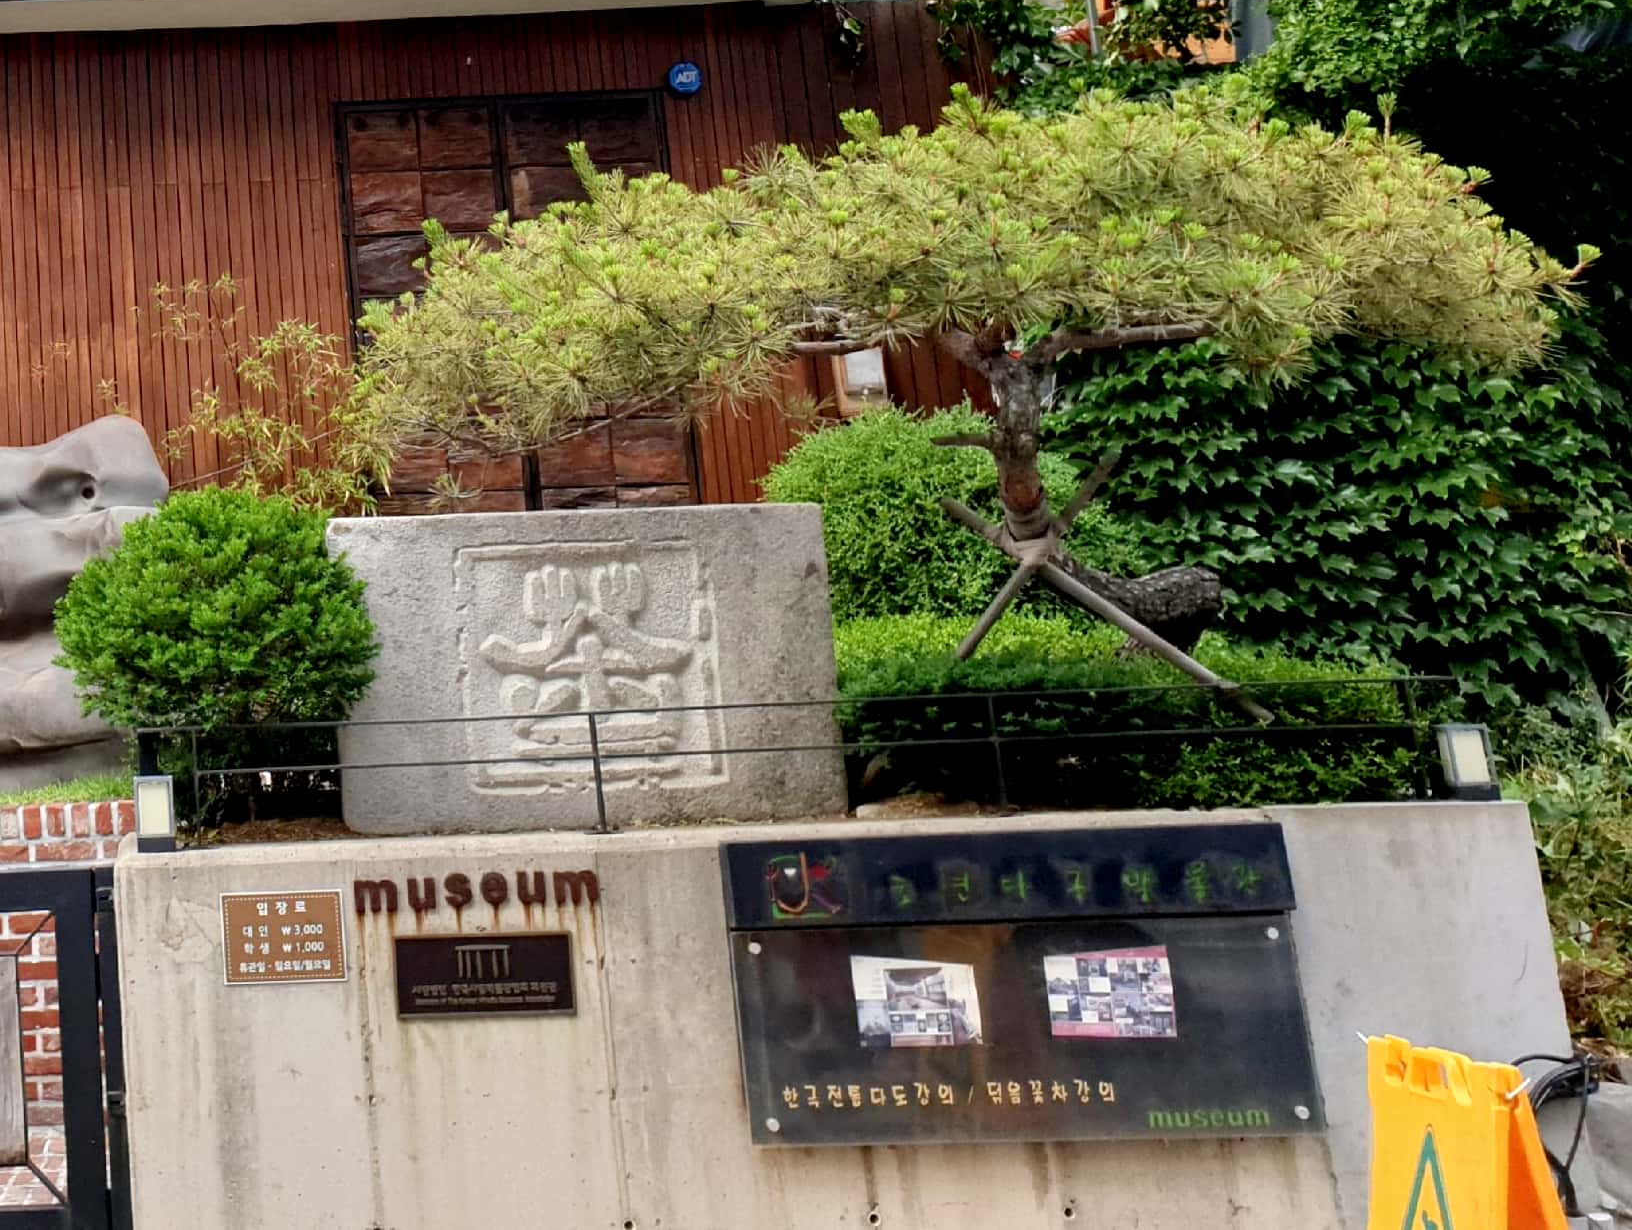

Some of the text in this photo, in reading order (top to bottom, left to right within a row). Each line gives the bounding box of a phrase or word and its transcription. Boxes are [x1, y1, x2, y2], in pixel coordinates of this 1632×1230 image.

[676, 71, 697, 83] ADT
[354, 870, 600, 913] museum
[1148, 1108, 1270, 1128] museum
